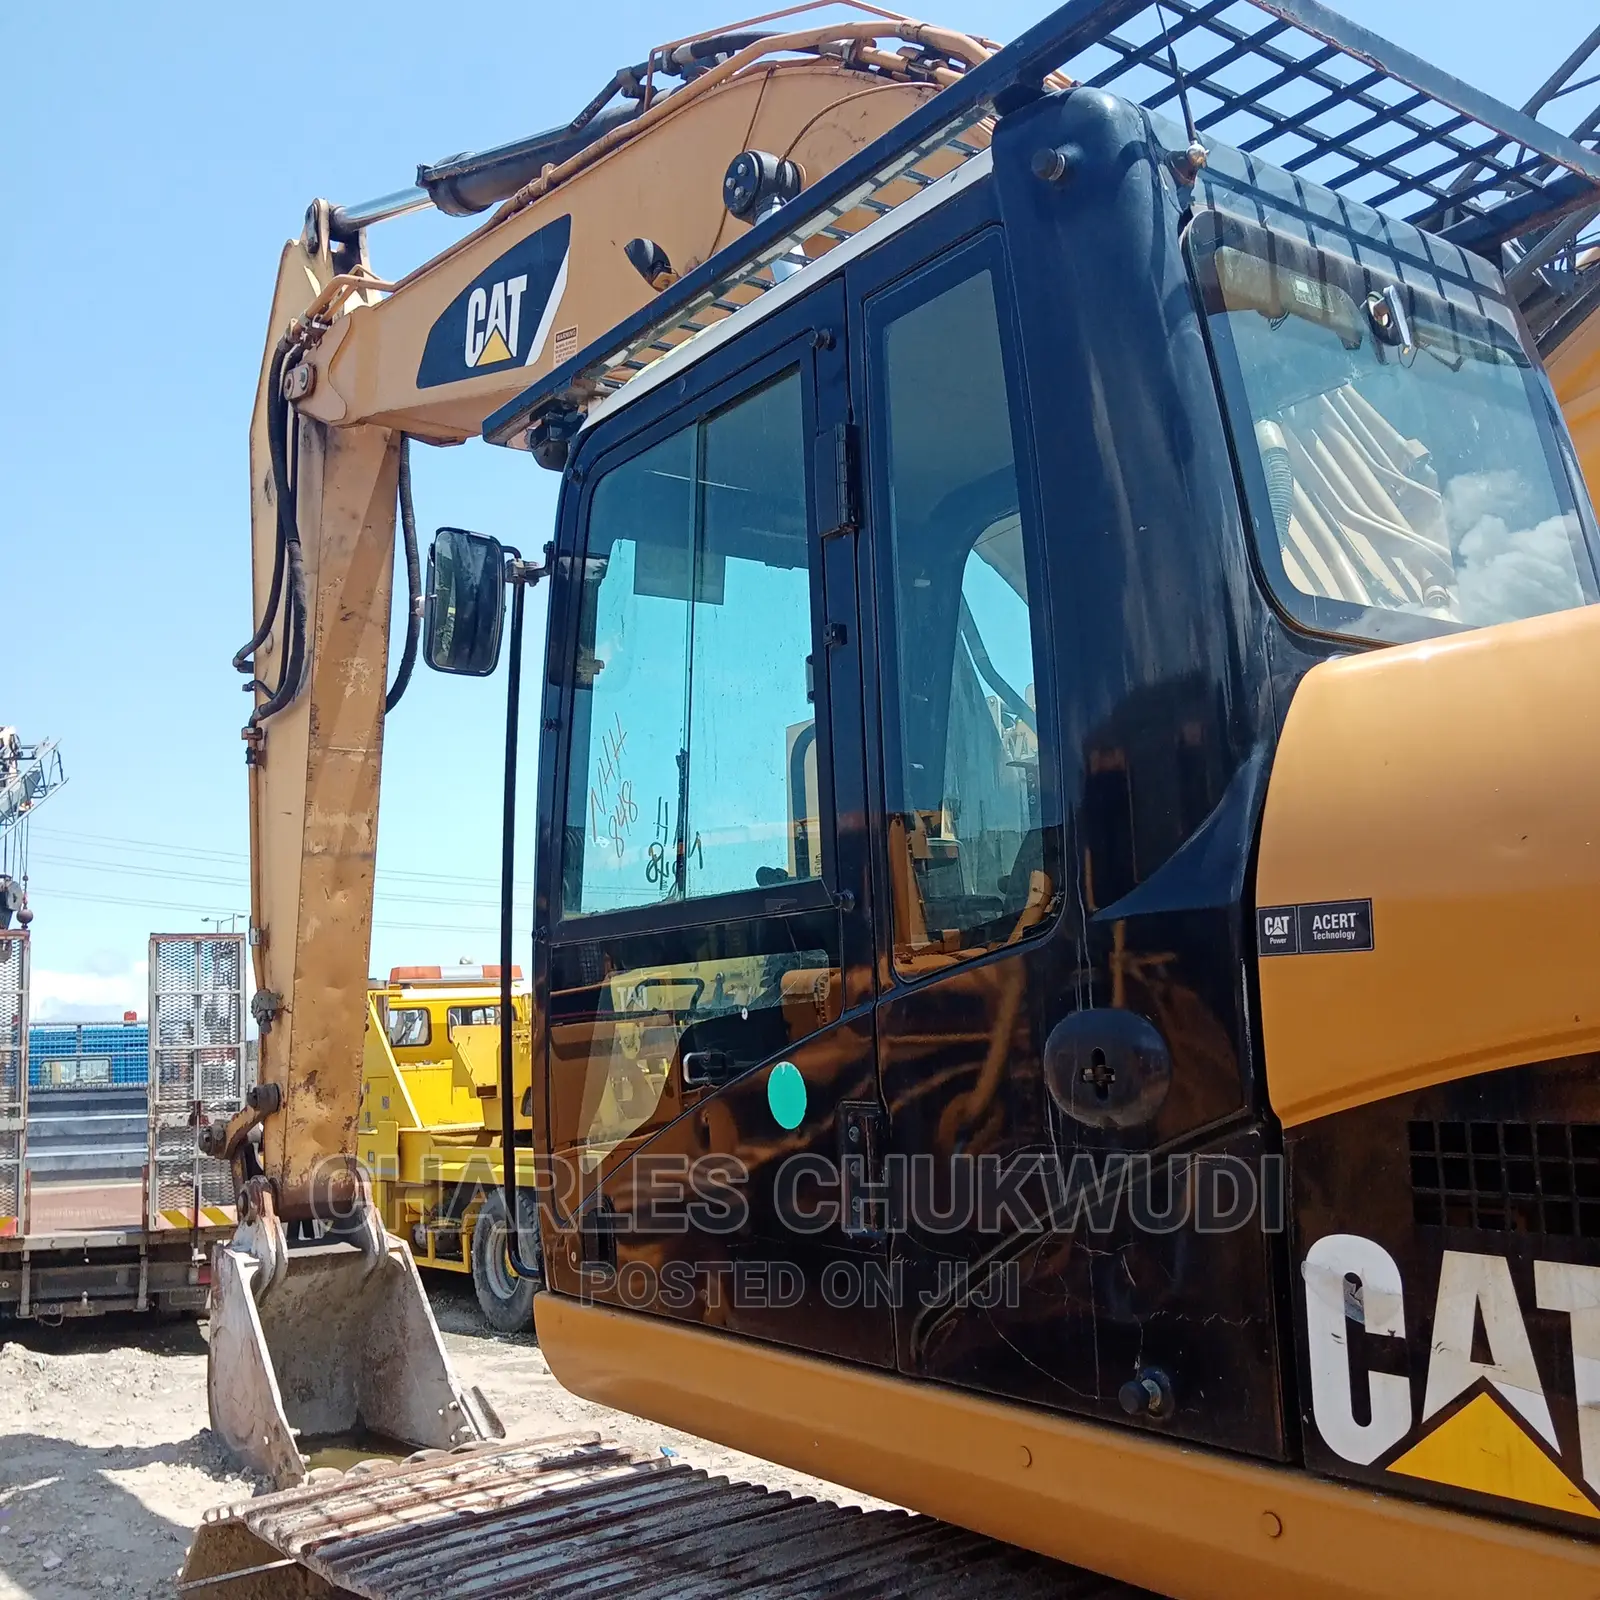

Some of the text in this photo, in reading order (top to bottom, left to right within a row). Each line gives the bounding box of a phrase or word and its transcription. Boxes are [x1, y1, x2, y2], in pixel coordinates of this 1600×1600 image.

[464, 274, 528, 368] CAT
[1264, 915, 1290, 936] CAT
[1312, 912, 1357, 930] ACERT
[1269, 936, 1287, 945] Power
[1312, 929, 1356, 941] Technology
